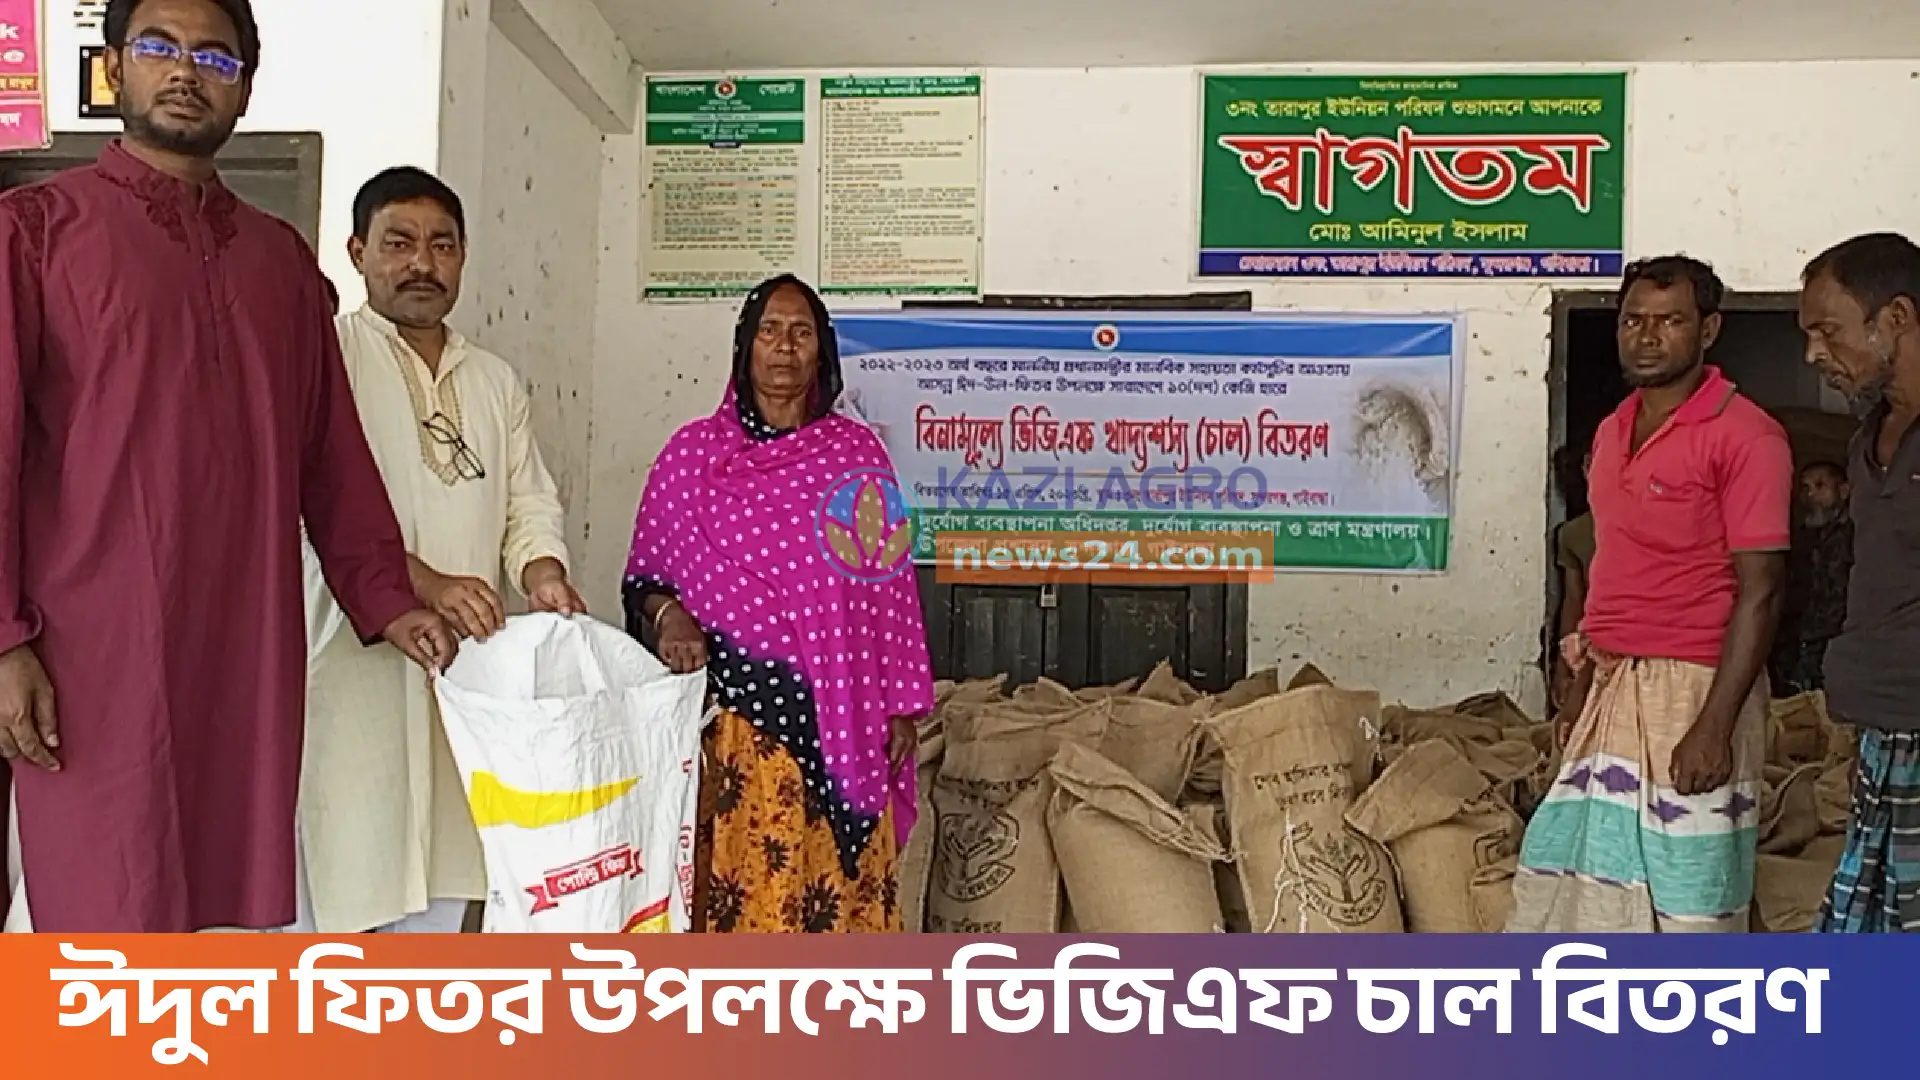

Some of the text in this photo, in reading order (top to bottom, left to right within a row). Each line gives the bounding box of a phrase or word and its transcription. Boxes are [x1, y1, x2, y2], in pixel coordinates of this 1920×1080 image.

[1226, 100, 1258, 119] ৩নং
[1264, 99, 1321, 120] তারাপুর
[1326, 96, 1389, 117] ইউনিয়ন
[1394, 96, 1444, 117] পরিষদ
[1530, 98, 1602, 117] আপনাকে
[1217, 126, 1611, 215] স্বাগতম
[1308, 218, 1528, 245] মোঃ আমিনুল ইসলাম
[859, 357, 944, 373] ২০২২-২০২৩
[947, 356, 970, 372] অর্থ
[973, 359, 1008, 373] বছরে
[1011, 356, 1060, 373] মাননীয়
[1064, 356, 1131, 377] প্রধানমন্ত্রীর
[1135, 358, 1185, 374] মানবিক
[1188, 361, 1237, 375] সহায়তা
[1298, 362, 1350, 377] আওতায়
[917, 377, 953, 395] আসন্ন
[1055, 375, 1106, 393] উপলক্ষে
[1222, 377, 1255, 395] কেজি
[1010, 405, 1096, 461] ভিজিএফ
[1104, 414, 1189, 473] খাদ্যশস্য
[1196, 416, 1251, 464] (চাল)
[1257, 407, 1330, 461] বিতরণ
[1287, 521, 1302, 537] ও
[1308, 519, 1341, 538] ত্রাণ
